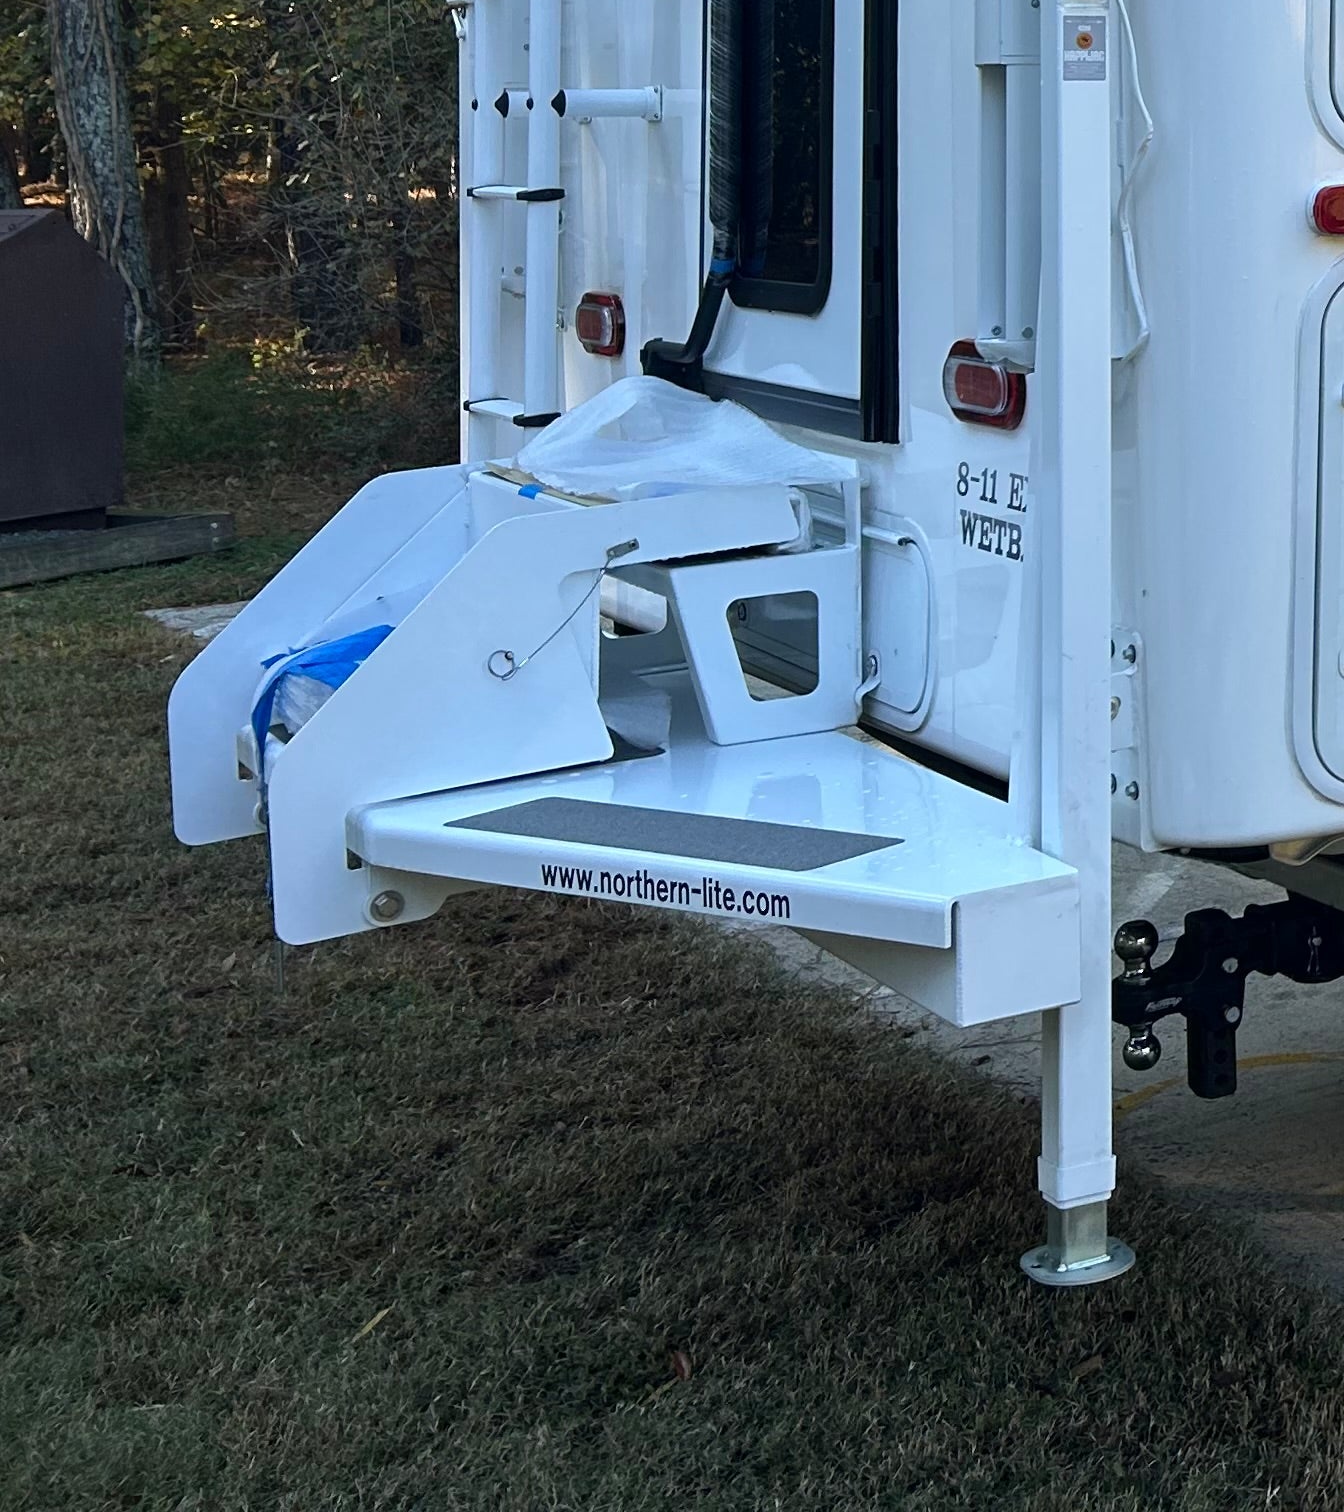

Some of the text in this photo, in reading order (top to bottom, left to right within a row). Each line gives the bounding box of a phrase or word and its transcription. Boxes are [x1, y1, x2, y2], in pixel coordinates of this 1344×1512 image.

[956, 461, 1029, 513] 8-11 E
[959, 508, 1024, 563] WETB
[541, 863, 791, 919] www.northern-lite.com
